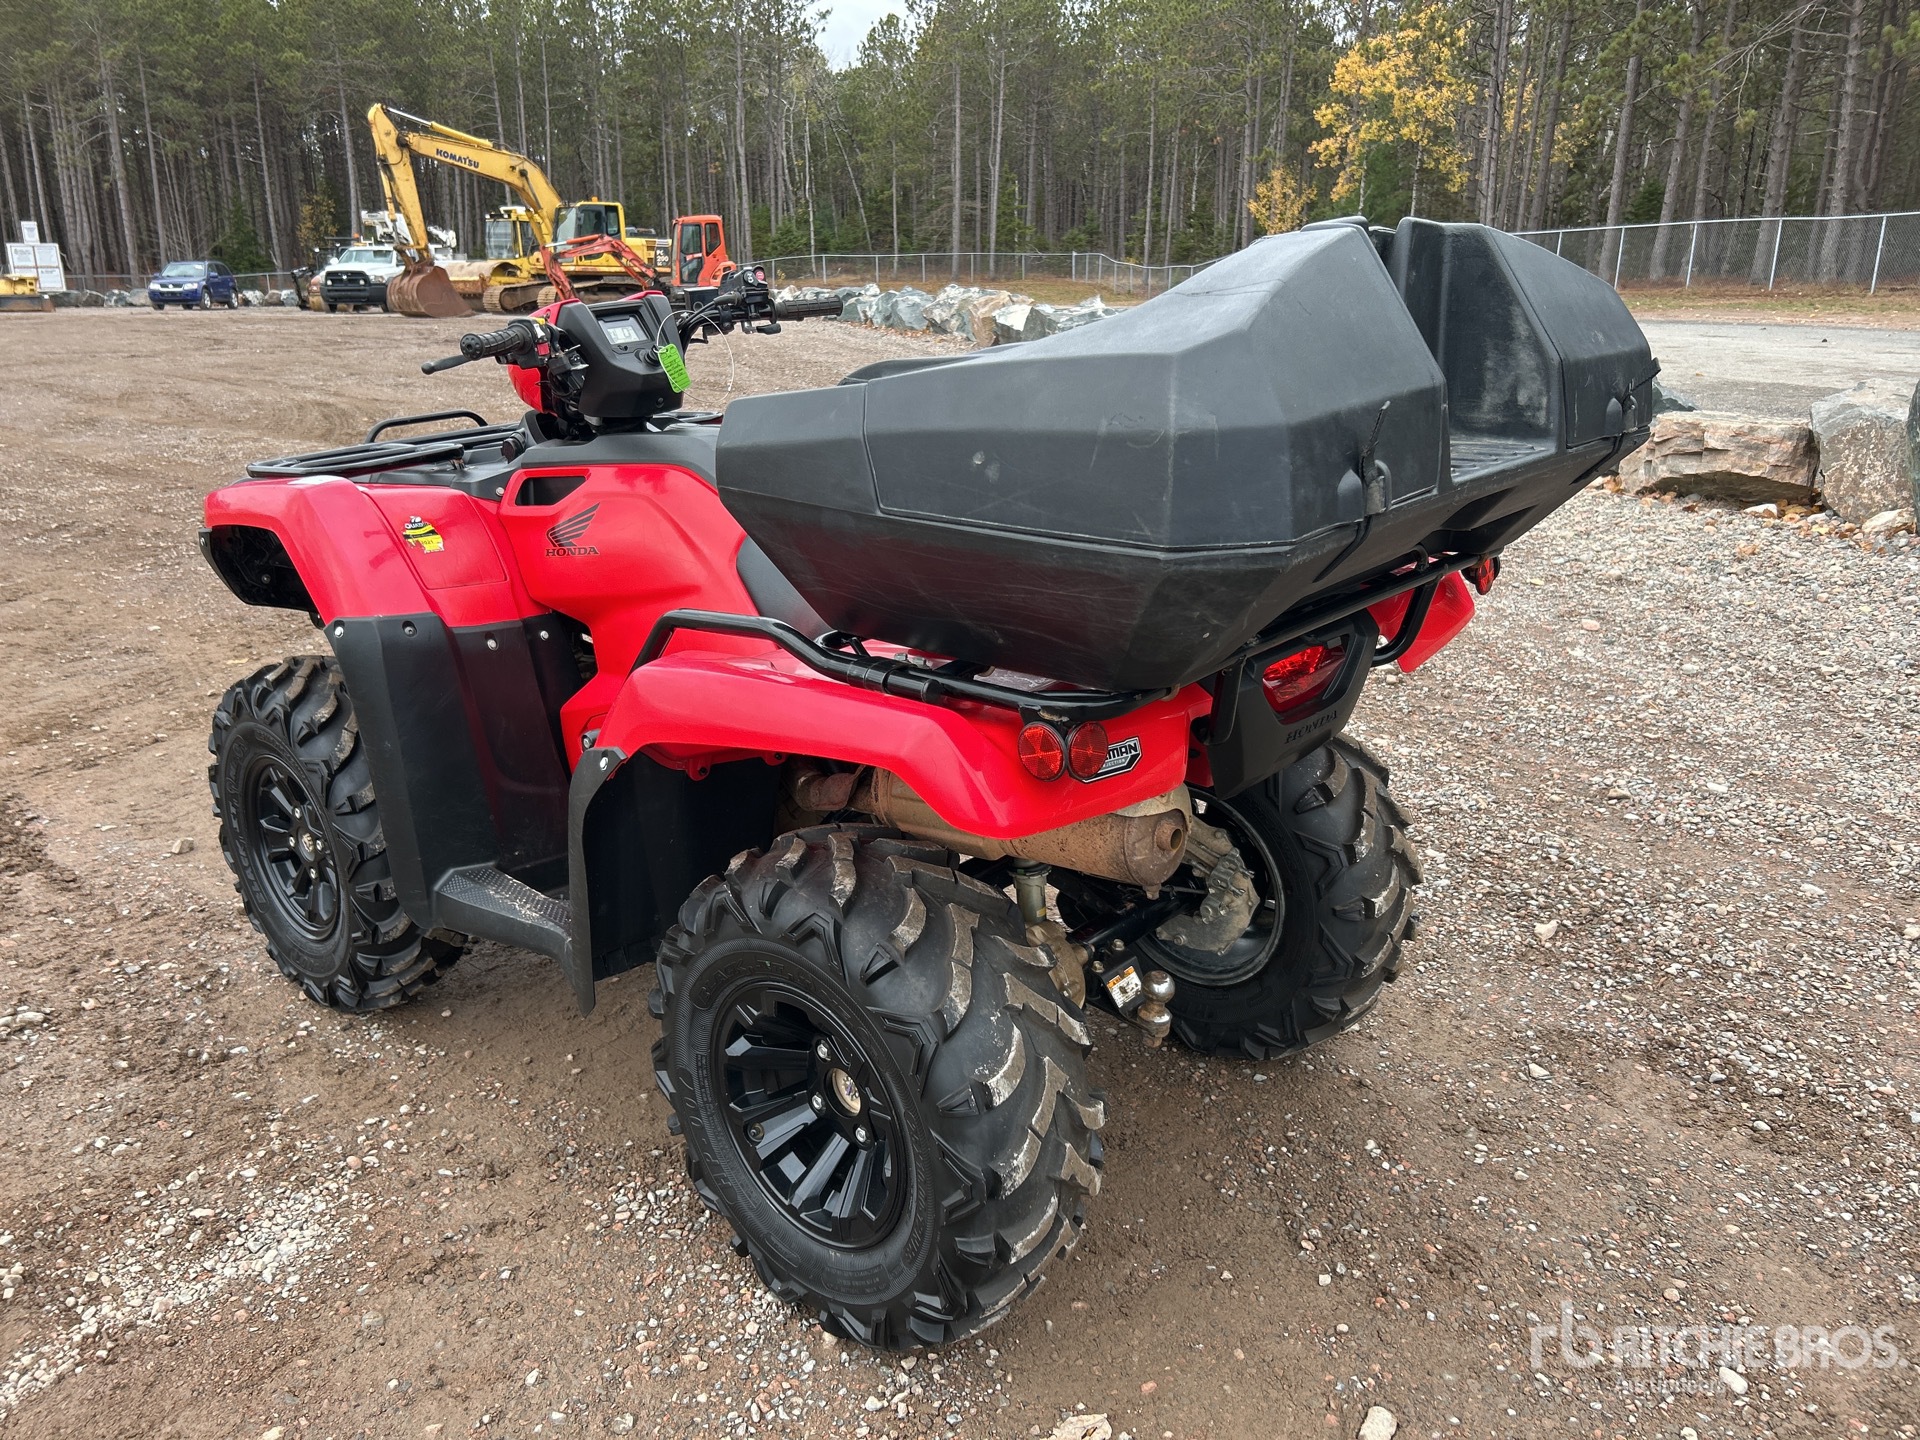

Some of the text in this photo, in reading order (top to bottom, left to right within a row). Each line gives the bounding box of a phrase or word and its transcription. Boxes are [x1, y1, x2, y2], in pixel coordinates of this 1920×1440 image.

[435, 148, 480, 169] KOMATSU
[545, 546, 600, 557] HONDA
[1284, 710, 1337, 744] HONDA
[1105, 742, 1138, 761] MAN
